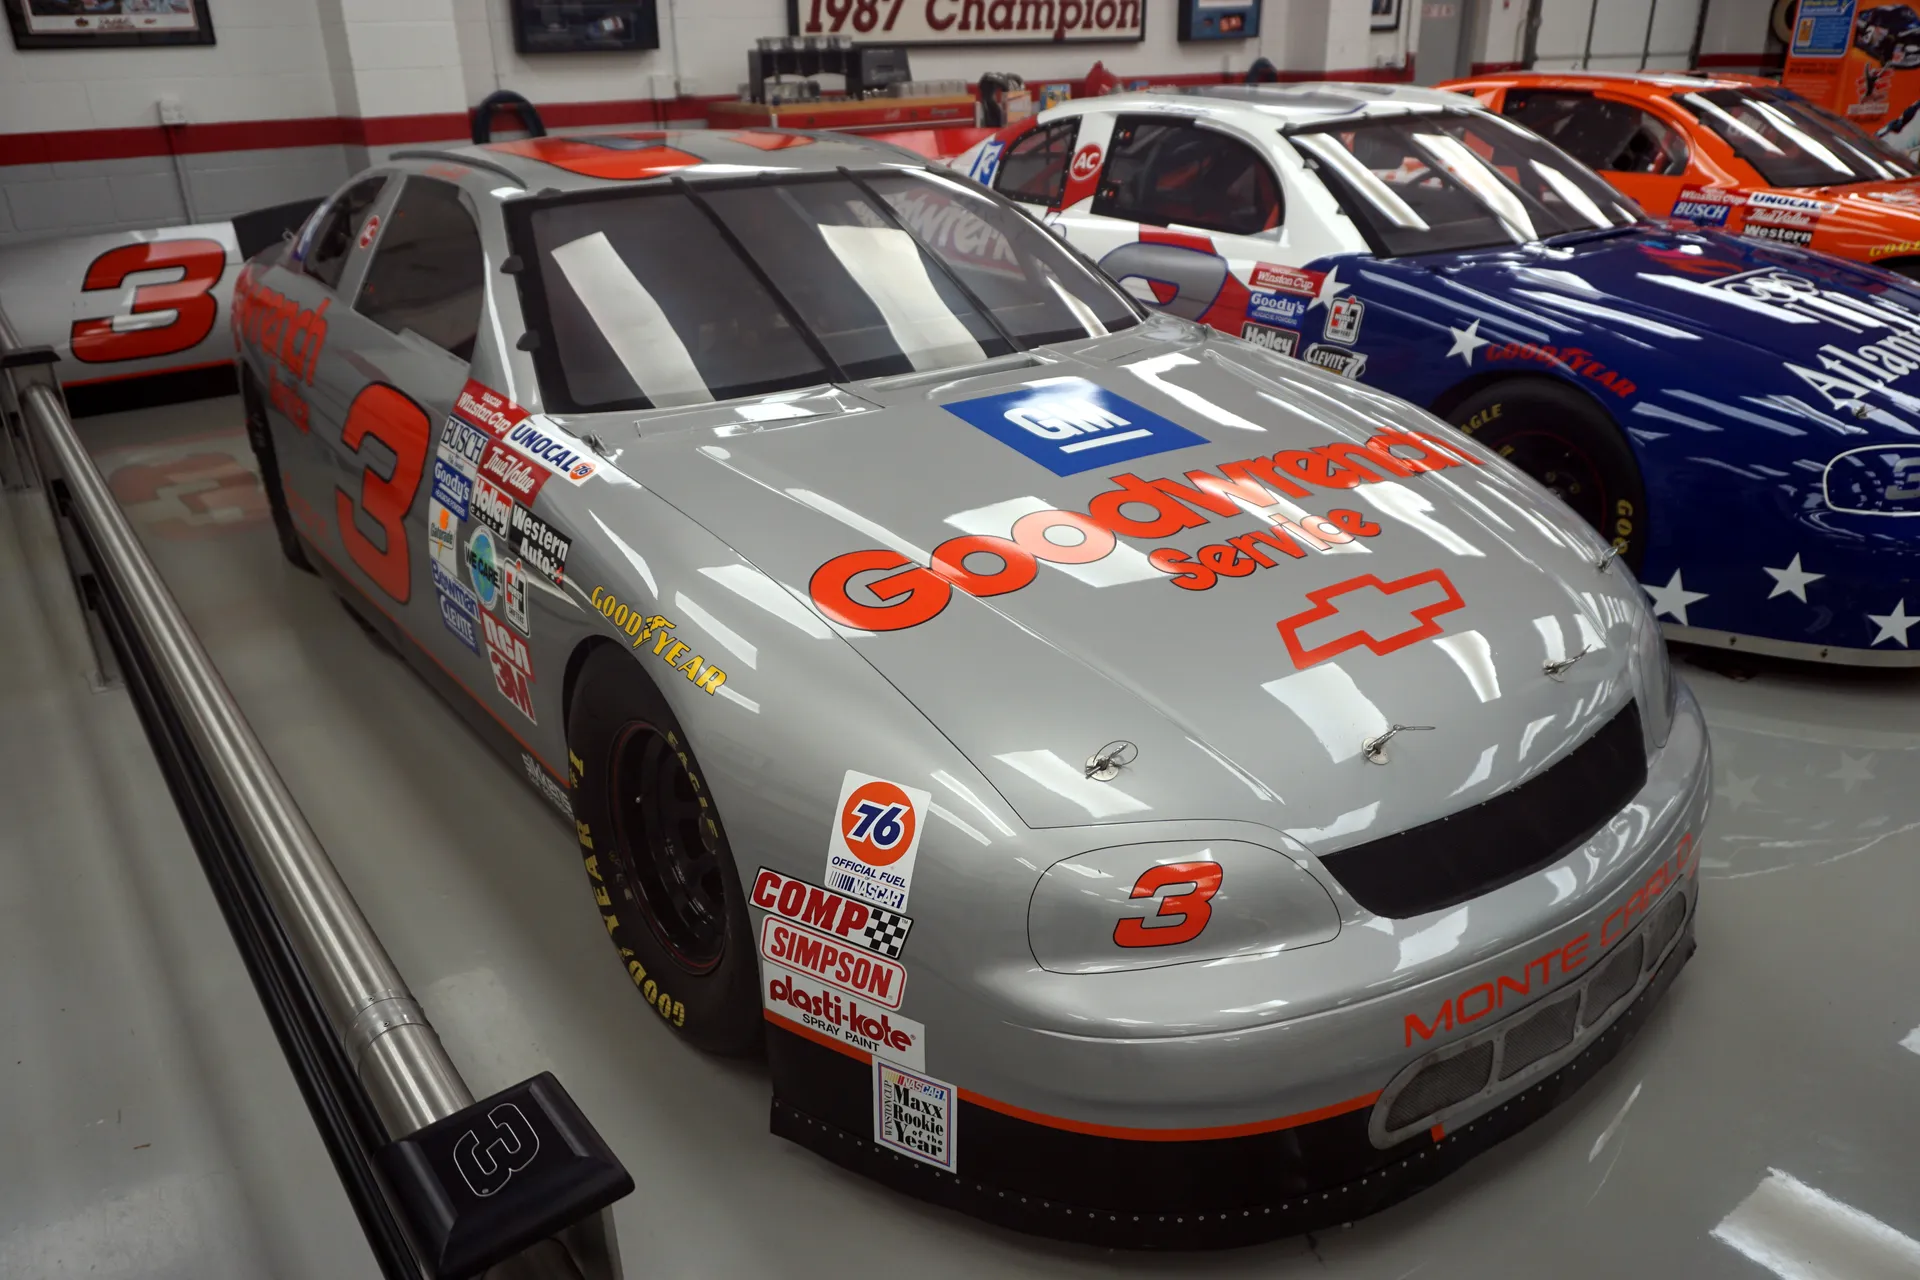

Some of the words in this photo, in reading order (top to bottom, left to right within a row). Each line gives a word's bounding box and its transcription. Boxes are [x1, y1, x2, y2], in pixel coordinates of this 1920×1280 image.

[805, 0, 905, 33] 1987
[925, 0, 1140, 40] Champion
[1074, 151, 1102, 172] AC
[1673, 201, 1727, 219] BUSCH
[1753, 193, 1820, 209] UNOCAL
[1743, 224, 1813, 243] Western
[71, 238, 227, 363] 3
[1257, 271, 1293, 287] Winston
[1293, 278, 1314, 291] Cup
[1251, 292, 1306, 316] Goody's
[1244, 326, 1293, 356] Holley
[1306, 343, 1345, 370] CLEVITE
[1485, 342, 1637, 398] GOODYEAR
[457, 391, 490, 423] Winston
[489, 411, 512, 434] Cup
[1004, 399, 1131, 440] GM
[441, 420, 488, 466] BUSCH
[510, 423, 579, 473] UNOCAL
[434, 461, 471, 501] Goody's
[483, 445, 509, 478] True
[502, 454, 536, 494] Value
[576, 464, 591, 477] 76
[335, 380, 432, 606] 3
[472, 477, 511, 536] Holley
[512, 504, 569, 562] Western
[808, 426, 1484, 632] Goodwrench
[1148, 507, 1382, 591] Service
[464, 546, 478, 570] WE
[478, 559, 500, 588] CARE
[519, 538, 551, 577] Auto
[440, 594, 475, 642] CLEVITE
[591, 585, 728, 696] GOODYEAR
[490, 651, 536, 722] 3M
[848, 799, 910, 849] 76
[831, 856, 877, 879] OFFICIAL
[879, 871, 906, 889] FUEL
[852, 878, 905, 909] NASCAR
[753, 871, 870, 937] COMP
[1113, 861, 1223, 948] 3
[1404, 932, 1591, 1048] MONTE
[1601, 832, 1692, 948] CARLO
[771, 926, 893, 999] SIMPSON
[770, 975, 912, 1052] plasti-kote
[802, 1013, 841, 1036] SPRAY
[845, 1031, 880, 1052] PAINT
[893, 1083, 944, 1120] Maxx
[903, 1077, 945, 1100] NASCAR
[893, 1103, 944, 1136] Rookie
[893, 1119, 943, 1157] Year
[912, 1129, 923, 1138] of
[926, 1134, 943, 1146] the
[453, 1102, 540, 1197] 3
